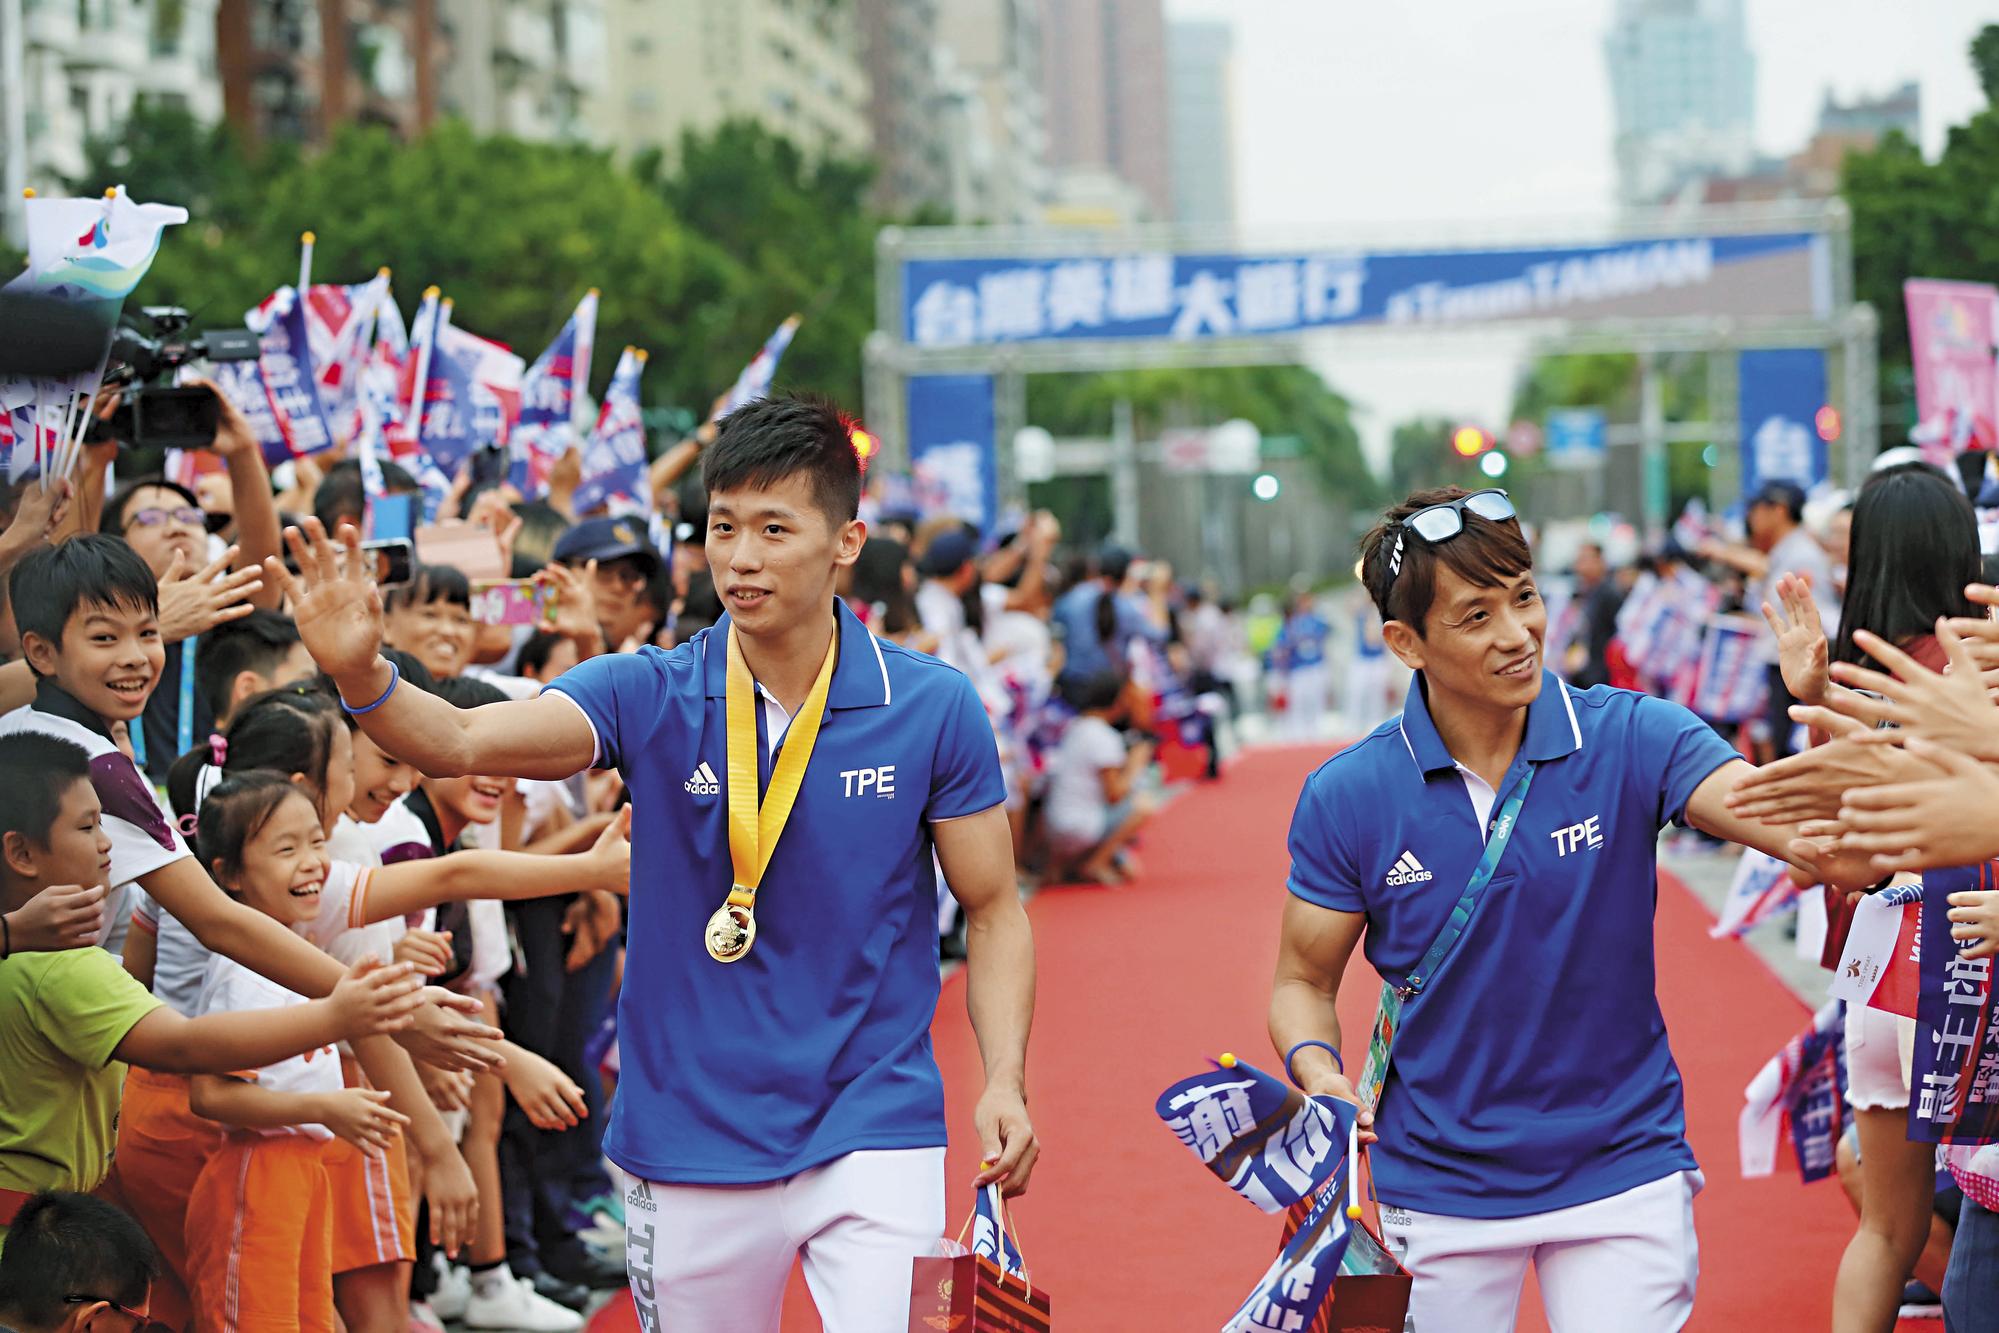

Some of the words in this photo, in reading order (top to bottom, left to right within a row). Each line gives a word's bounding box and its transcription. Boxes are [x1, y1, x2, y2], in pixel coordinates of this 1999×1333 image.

[840, 765, 896, 797] TPE
[1551, 814, 1603, 857] TPE
[1386, 870, 1433, 886] adidas
[627, 1194, 657, 1212] adidas
